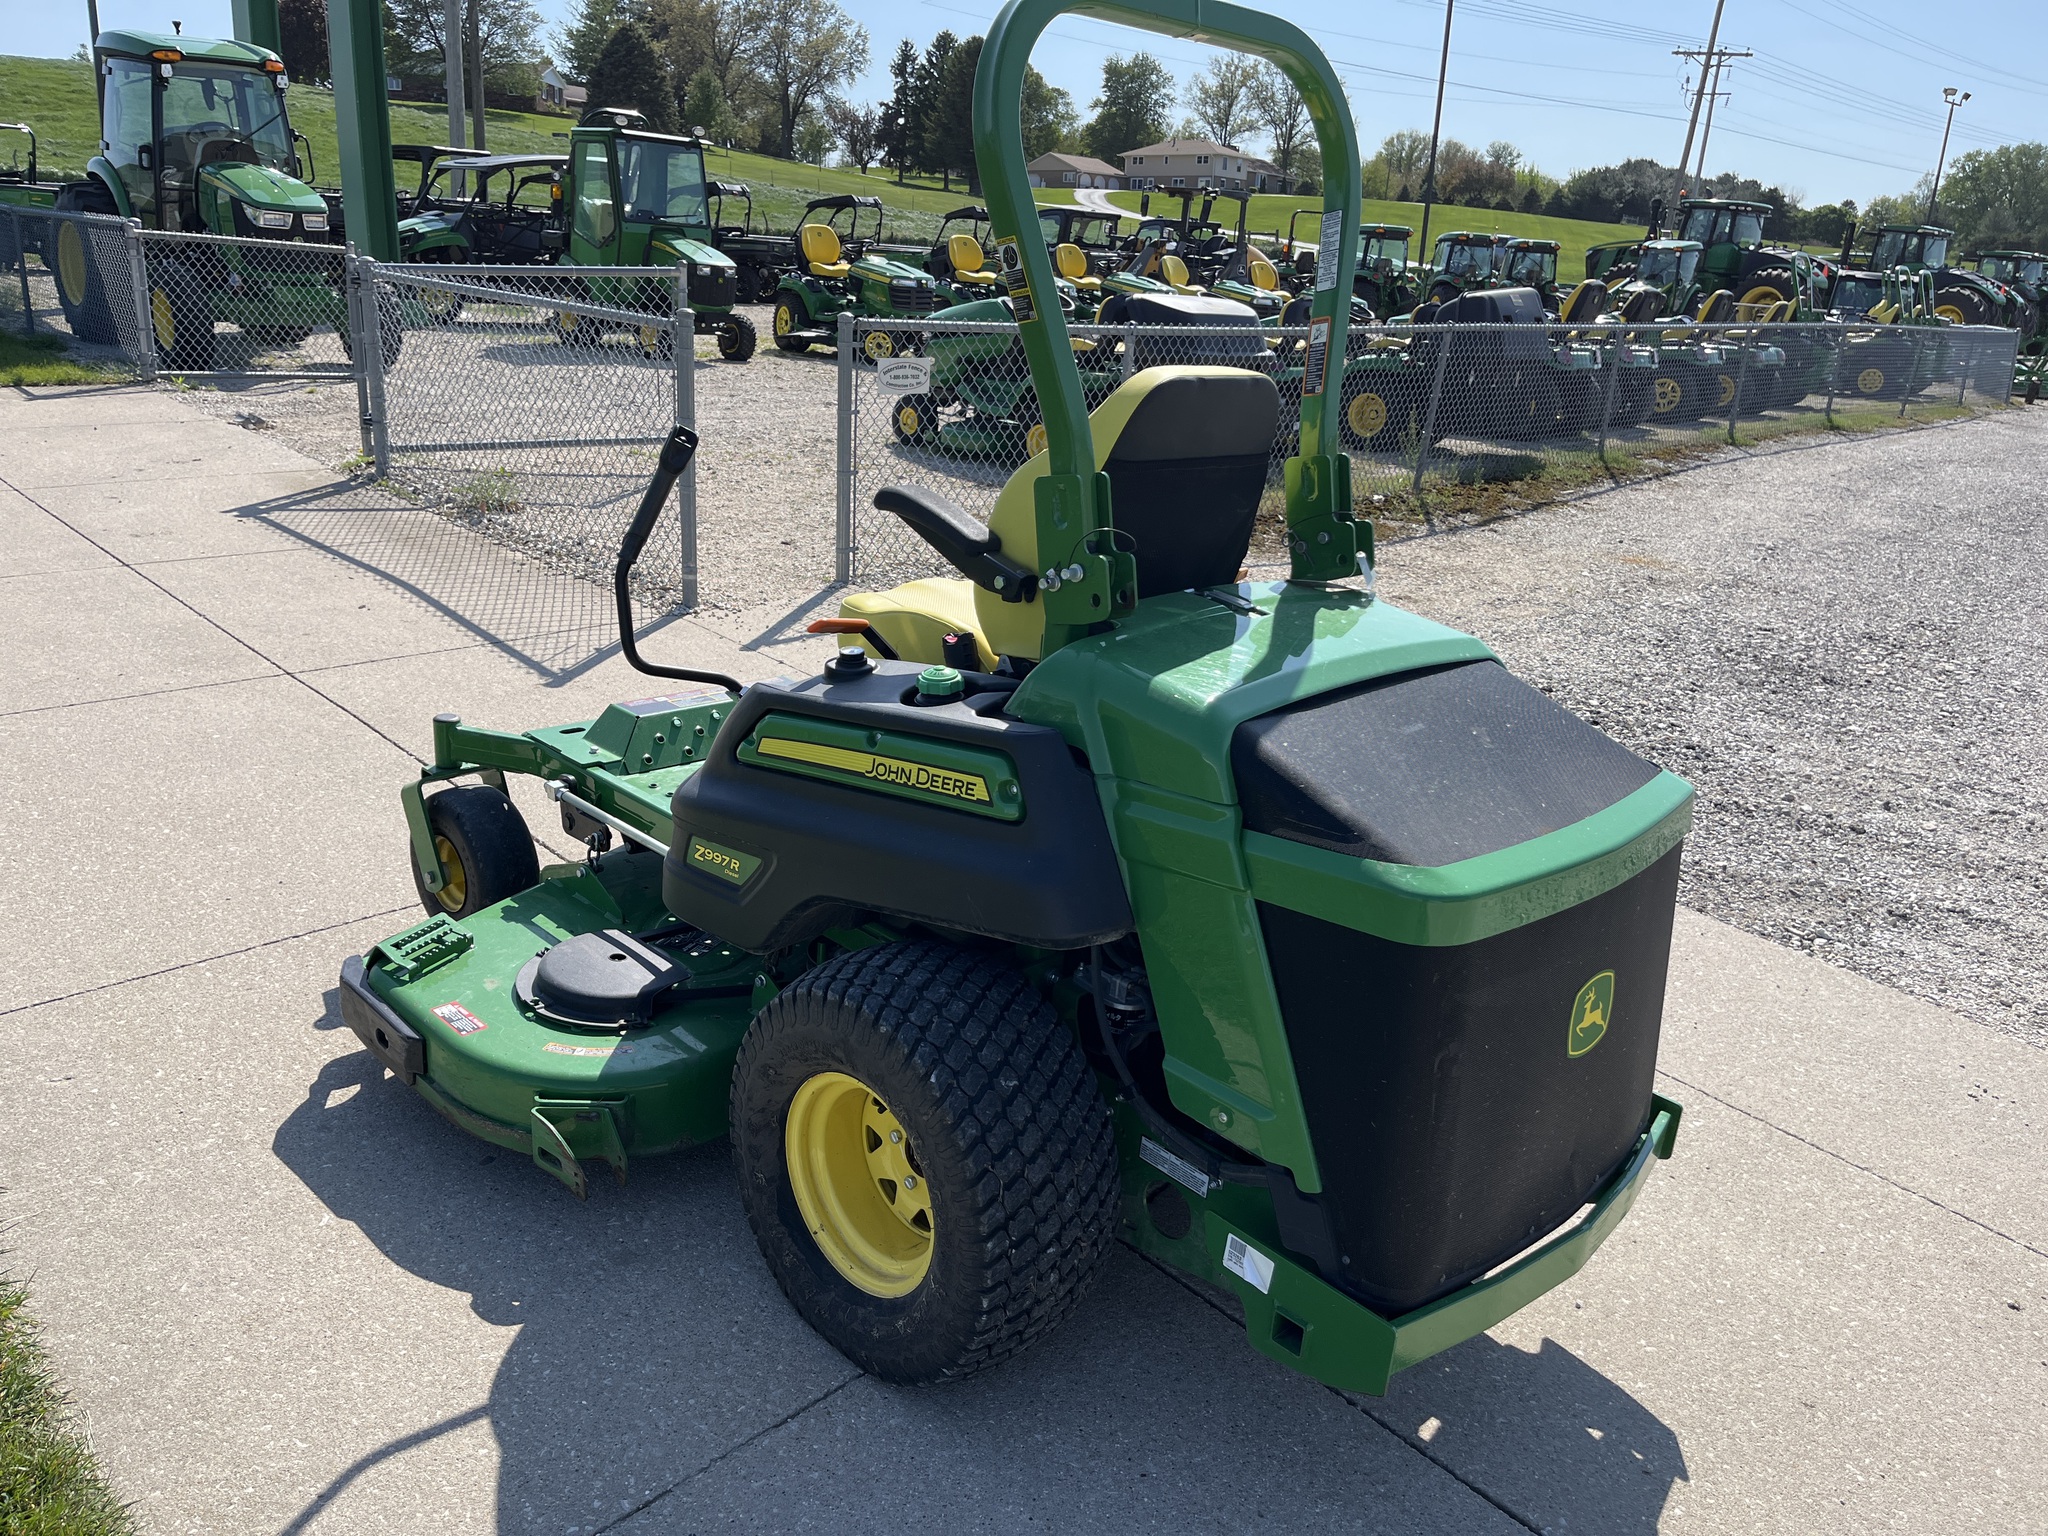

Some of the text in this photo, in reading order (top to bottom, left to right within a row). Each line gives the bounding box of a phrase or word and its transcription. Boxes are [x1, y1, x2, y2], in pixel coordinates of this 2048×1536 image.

[882, 364, 907, 376] Interstate
[908, 364, 923, 373] Fence
[865, 758, 977, 797] JOHN DEERE
[694, 844, 740, 872] Z997R
[724, 868, 739, 879] Diesel
